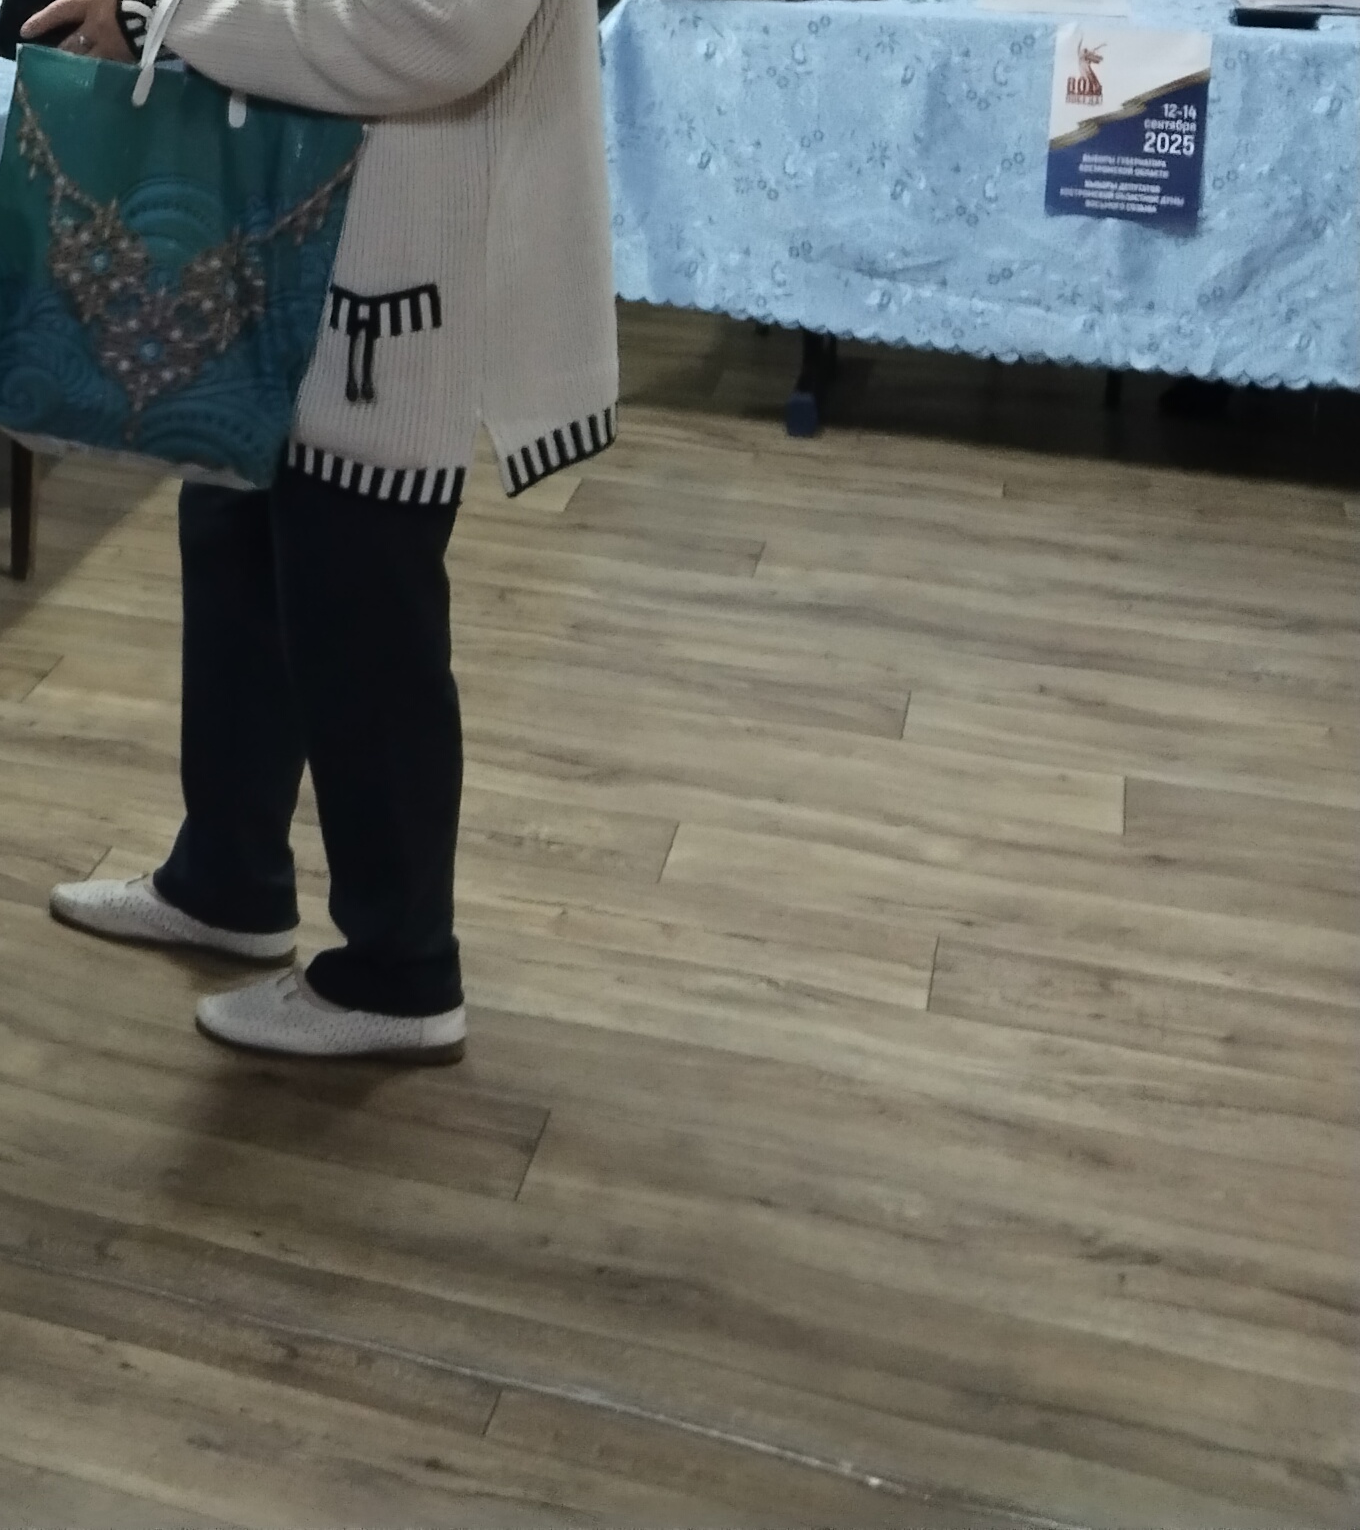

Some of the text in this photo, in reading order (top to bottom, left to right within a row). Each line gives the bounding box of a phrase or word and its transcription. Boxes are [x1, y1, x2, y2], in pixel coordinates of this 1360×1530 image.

[1163, 103, 1197, 120] 12-14
[1144, 119, 1197, 132] сентября
[1143, 132, 1195, 156] 2025
